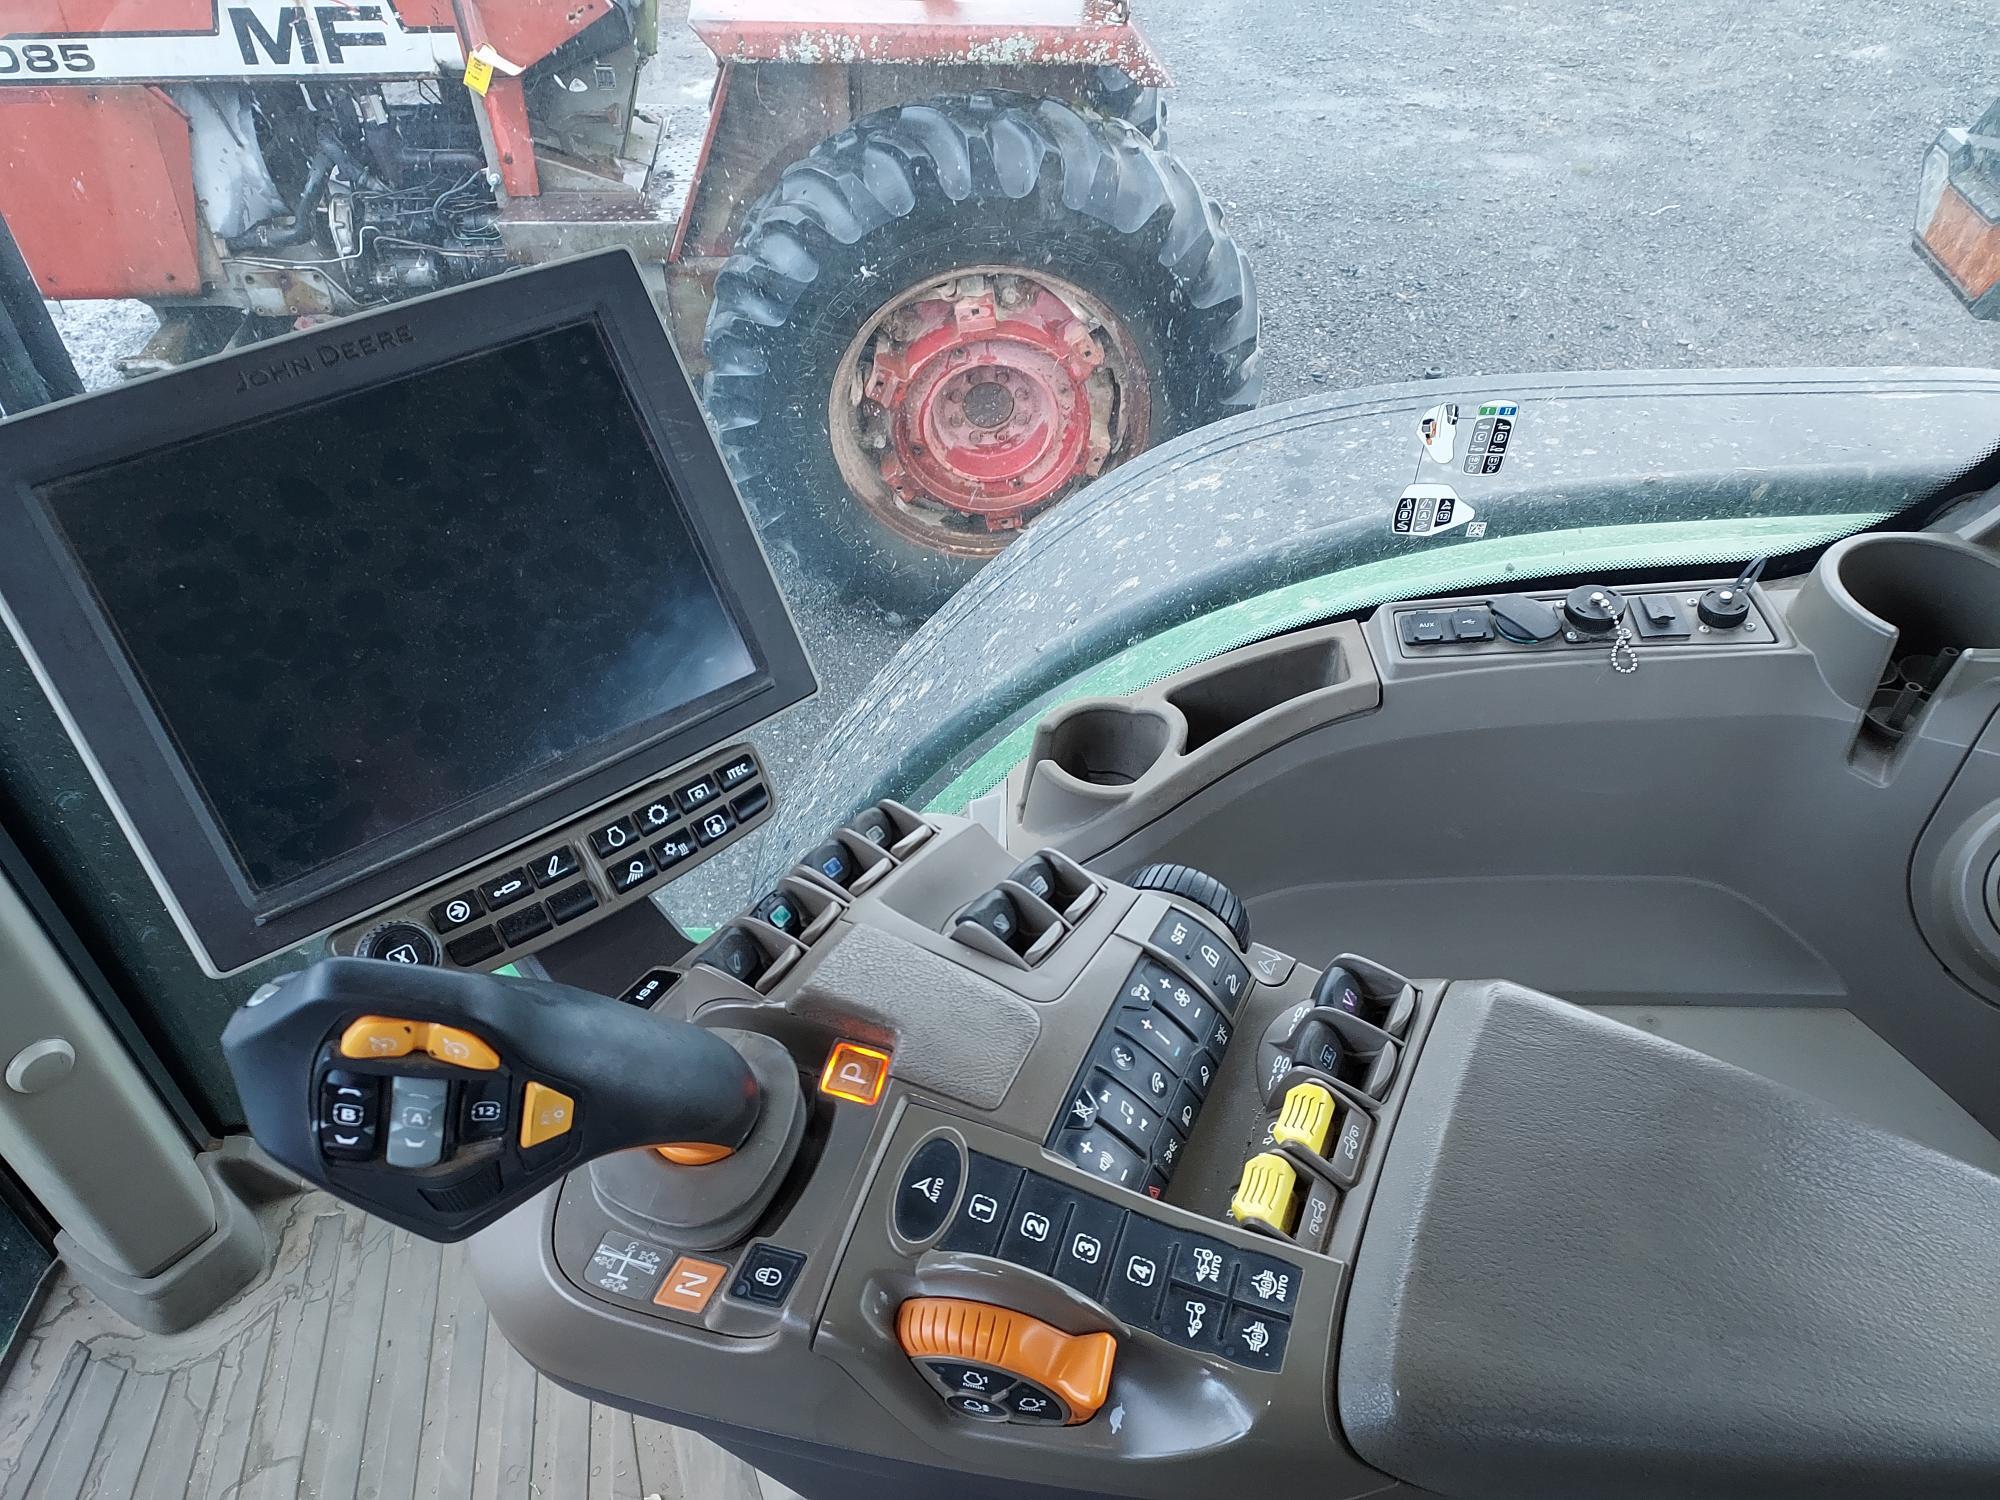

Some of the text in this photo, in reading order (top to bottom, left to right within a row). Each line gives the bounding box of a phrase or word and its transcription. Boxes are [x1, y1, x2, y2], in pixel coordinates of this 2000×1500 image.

[228, 6, 387, 65] MF
[235, 324, 416, 394] JOHN DEERE
[726, 762, 749, 780] ITEC
[1170, 922, 1188, 945] SET
[635, 980, 659, 1001] ISB
[840, 1062, 867, 1085] P
[340, 1105, 496, 1125] B A 12
[929, 1177, 944, 1203] AUTO
[1026, 1218, 1045, 1236] 2
[1077, 1240, 1096, 1257] 3
[1132, 1263, 1151, 1280] 4
[1208, 1255, 1223, 1282] AUTO
[674, 1271, 708, 1298] N
[1275, 1274, 1289, 1302] AUTO
